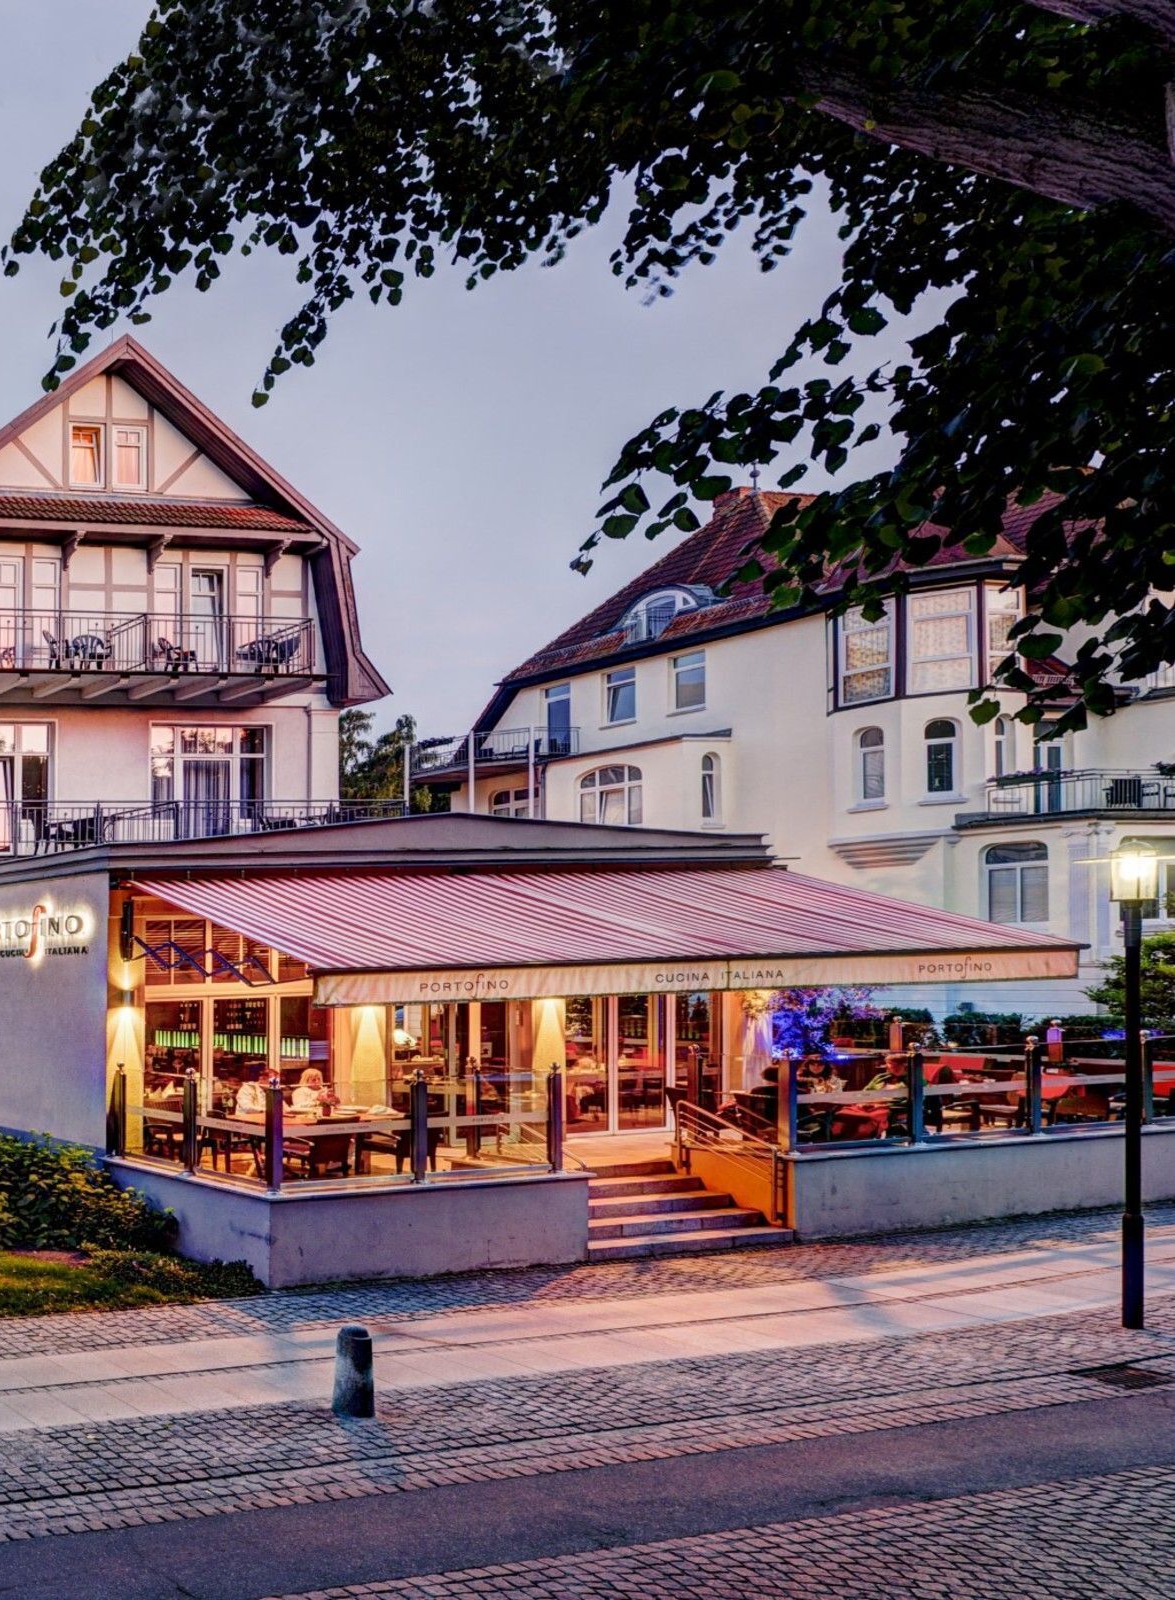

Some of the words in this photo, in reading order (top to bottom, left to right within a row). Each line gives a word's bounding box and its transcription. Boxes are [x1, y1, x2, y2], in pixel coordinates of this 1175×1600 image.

[0, 949, 29, 958] CUCIN
[44, 946, 89, 955] ITALIANA
[655, 972, 710, 983] CUCINA
[721, 969, 784, 980] ITALIANA
